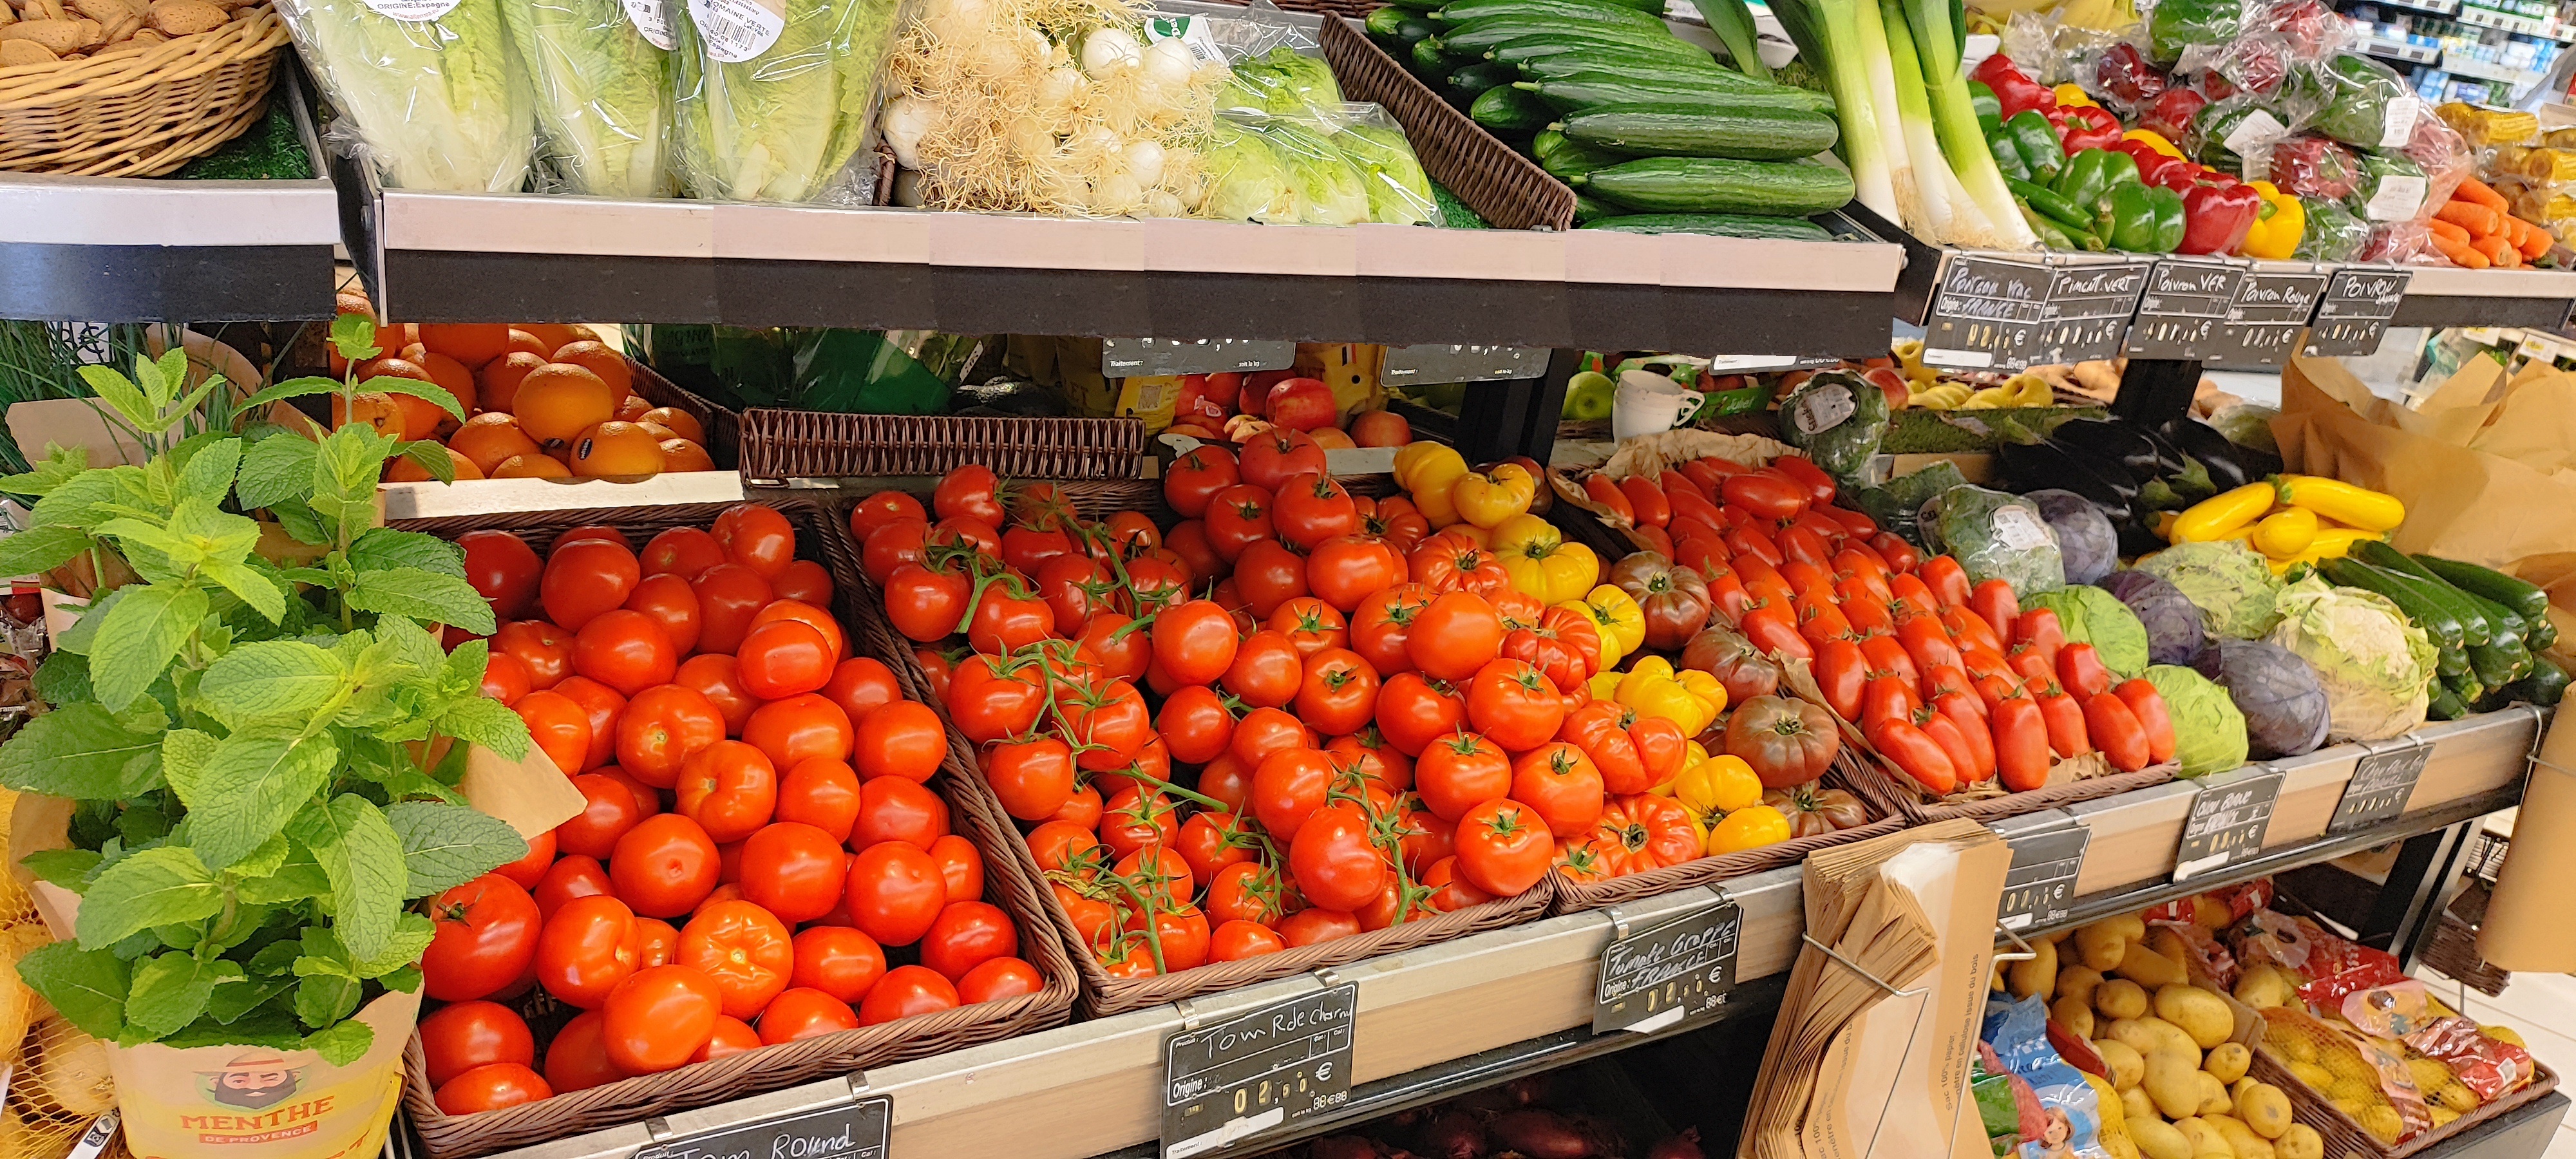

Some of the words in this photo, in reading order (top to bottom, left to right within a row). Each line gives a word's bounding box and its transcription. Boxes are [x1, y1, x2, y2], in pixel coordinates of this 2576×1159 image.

[746, 17, 770, 37] VERTE
[2053, 883, 2066, 901] €
[1708, 966, 1723, 984] €
[1200, 1026, 1267, 1060] Tom
[1315, 1062, 1333, 1082] €
[179, 1095, 335, 1130] MENTHE
[229, 1126, 312, 1144] PROVENCE
